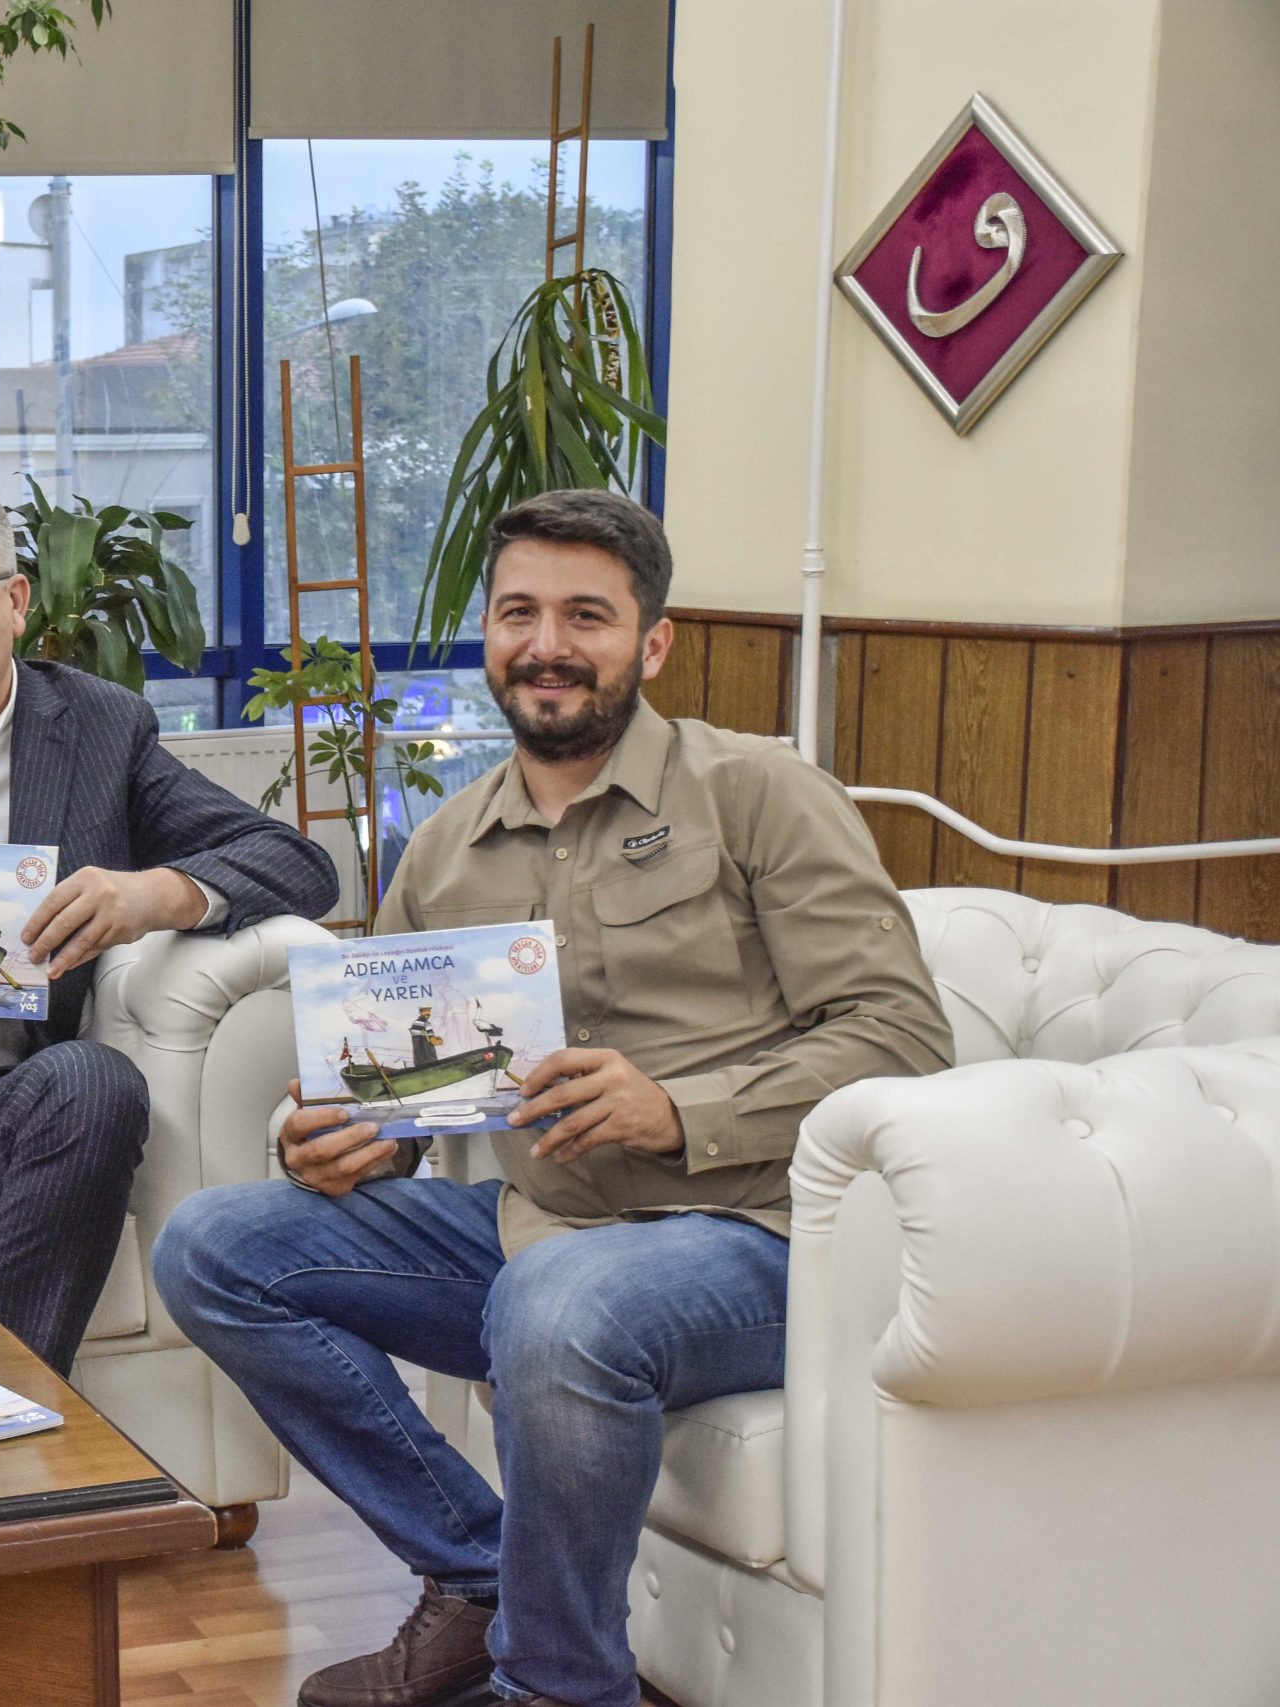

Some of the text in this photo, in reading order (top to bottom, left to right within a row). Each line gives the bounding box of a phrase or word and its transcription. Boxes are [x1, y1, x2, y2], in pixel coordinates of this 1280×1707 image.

[344, 955, 454, 977] ADEM AMCA
[392, 975, 408, 984] ve
[371, 984, 432, 1002] YAREN
[20, 1002, 38, 1012] yaş
